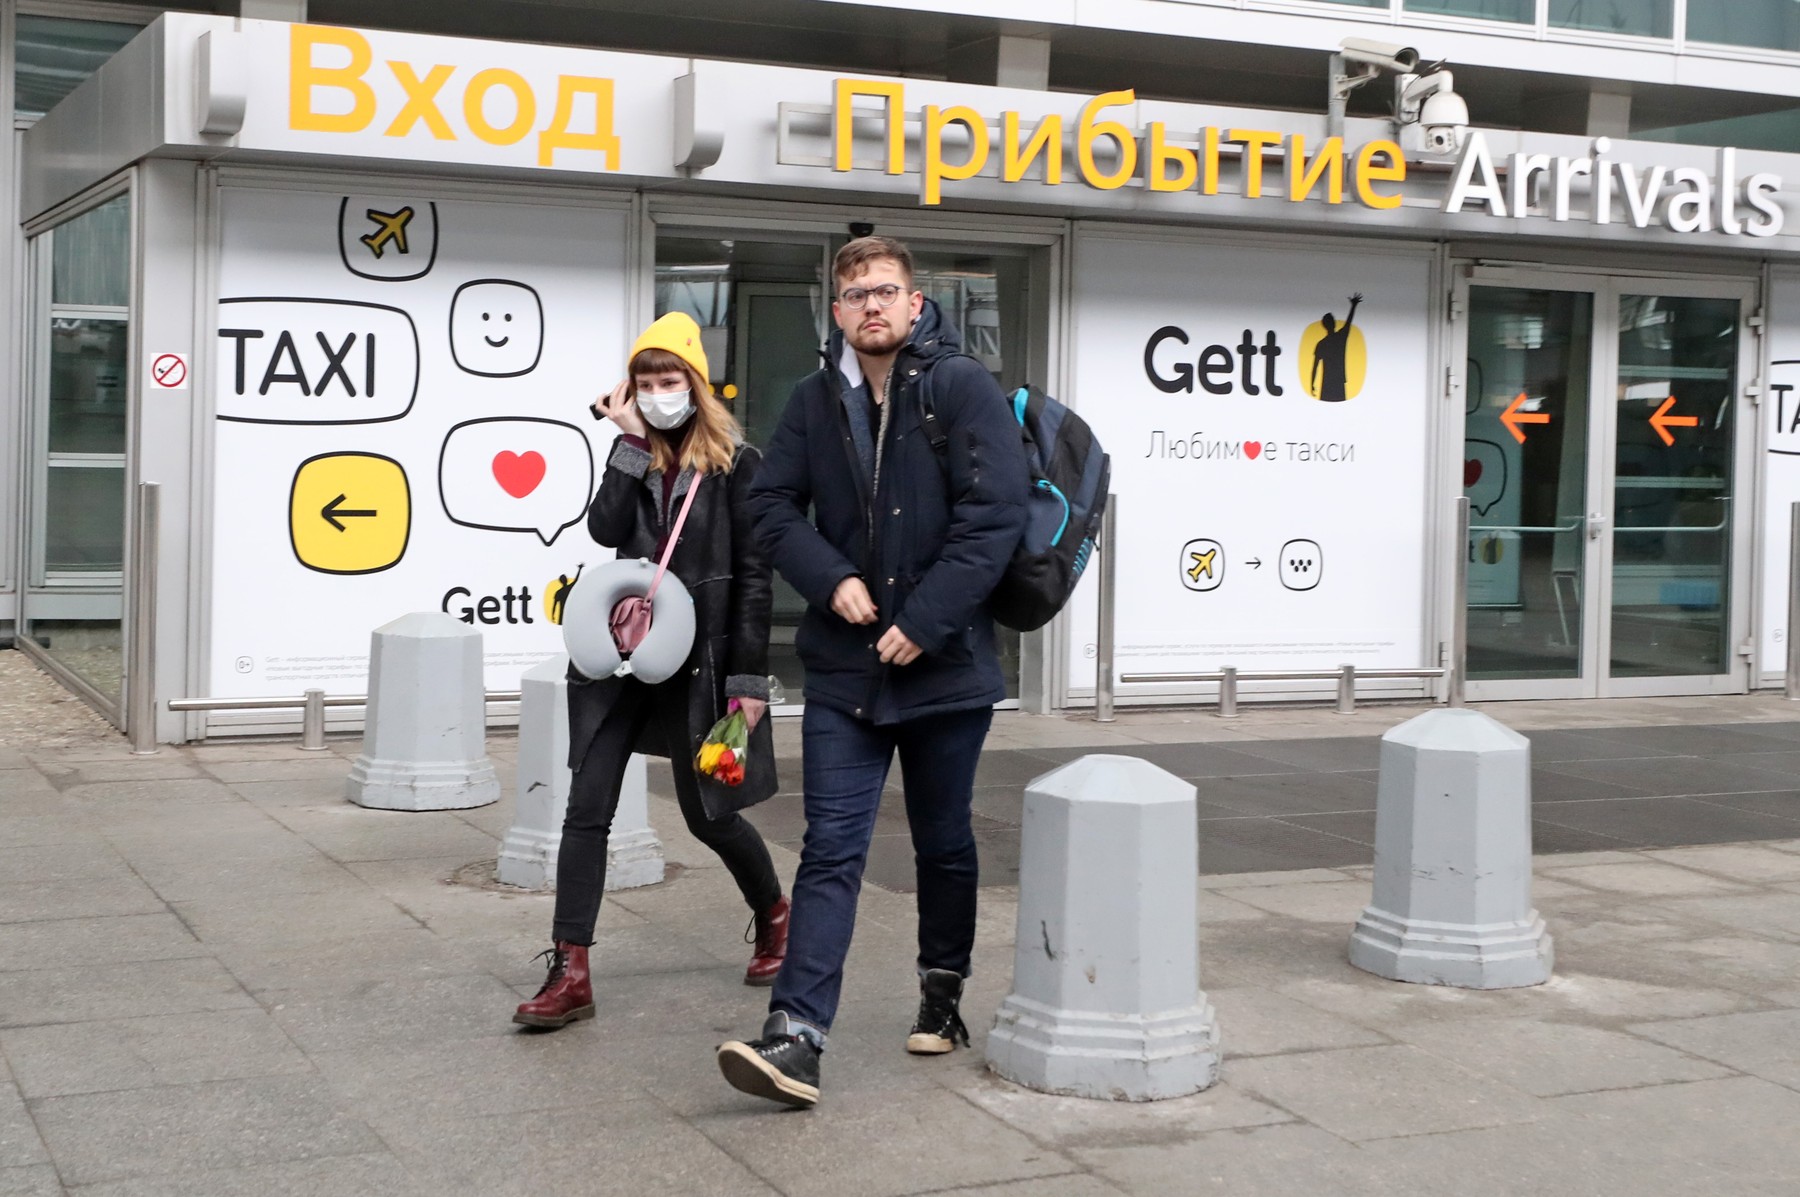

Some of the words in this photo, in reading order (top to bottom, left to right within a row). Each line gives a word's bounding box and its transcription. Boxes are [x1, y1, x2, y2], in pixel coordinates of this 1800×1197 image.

[288, 23, 621, 171] Вход
[831, 78, 1406, 210] Прибытие
[1442, 131, 1785, 237] Arrivals
[218, 328, 375, 398] TAXI
[1144, 325, 1283, 397] Gett
[1286, 440, 1355, 463] такси
[441, 585, 534, 625] Gett
